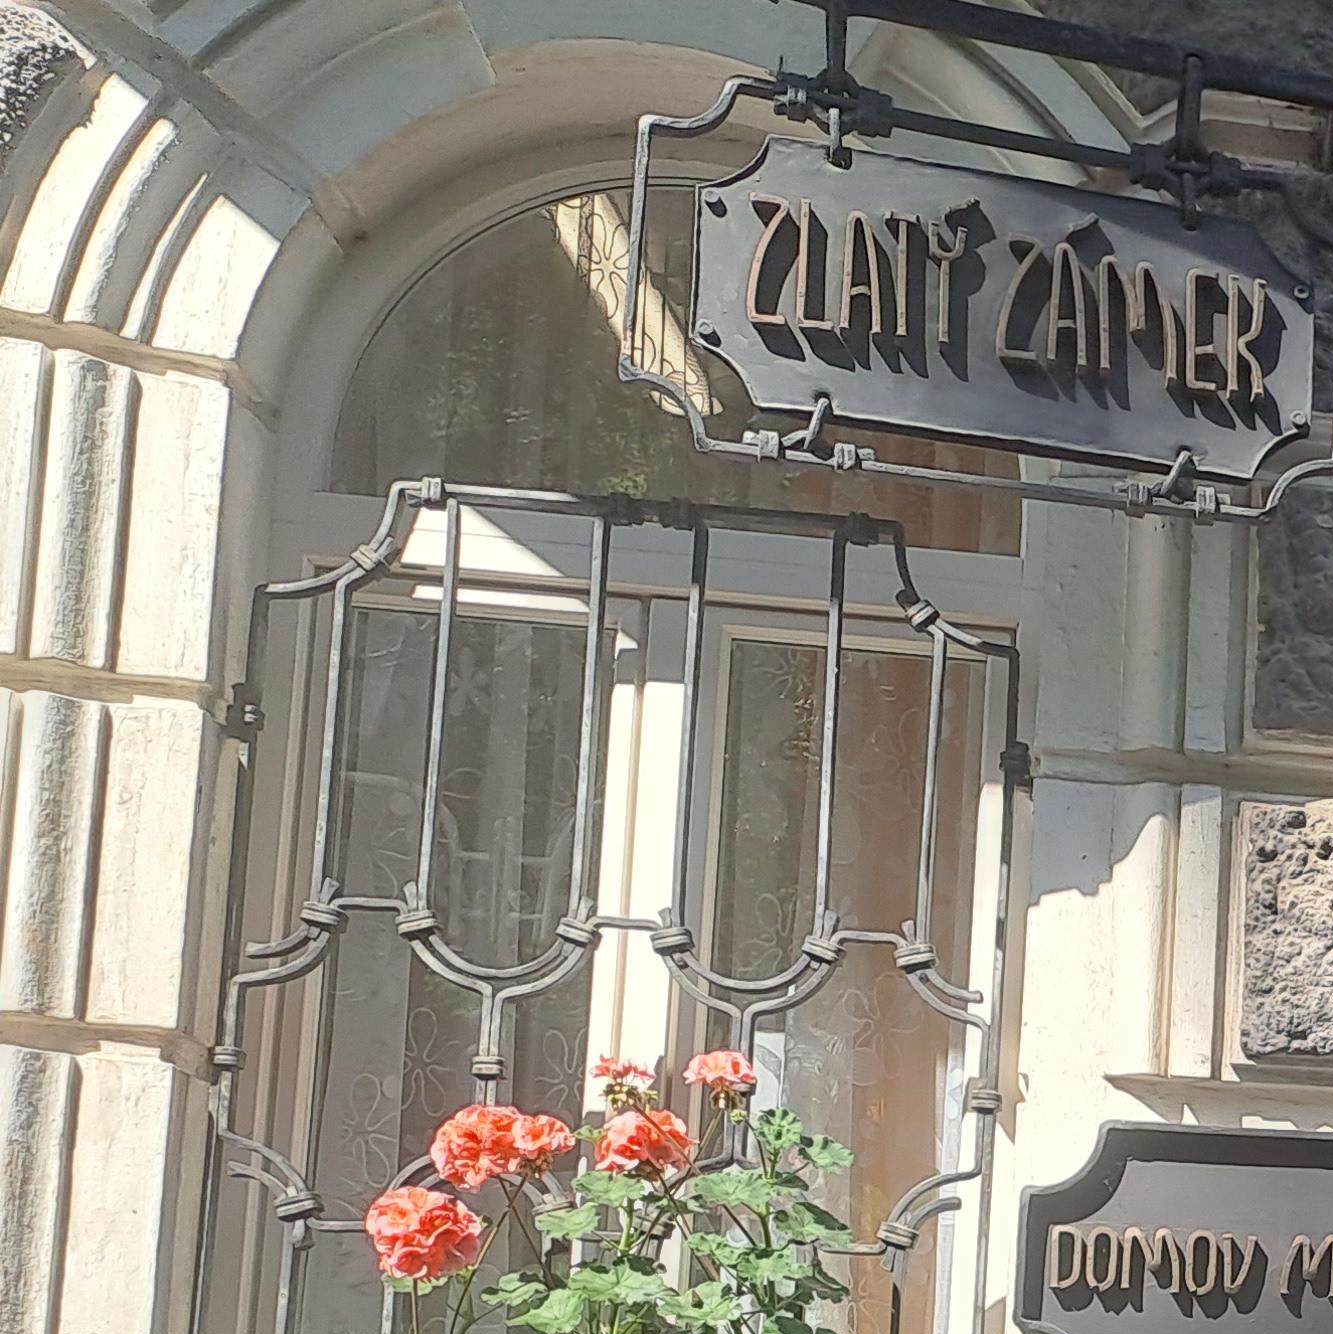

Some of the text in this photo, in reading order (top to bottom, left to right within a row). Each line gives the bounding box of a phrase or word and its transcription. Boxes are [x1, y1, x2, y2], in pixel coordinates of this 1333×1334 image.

[746, 192, 1268, 402] ZLATÝ ZÁMEK
[1048, 1223, 1257, 1295] DOMOV
